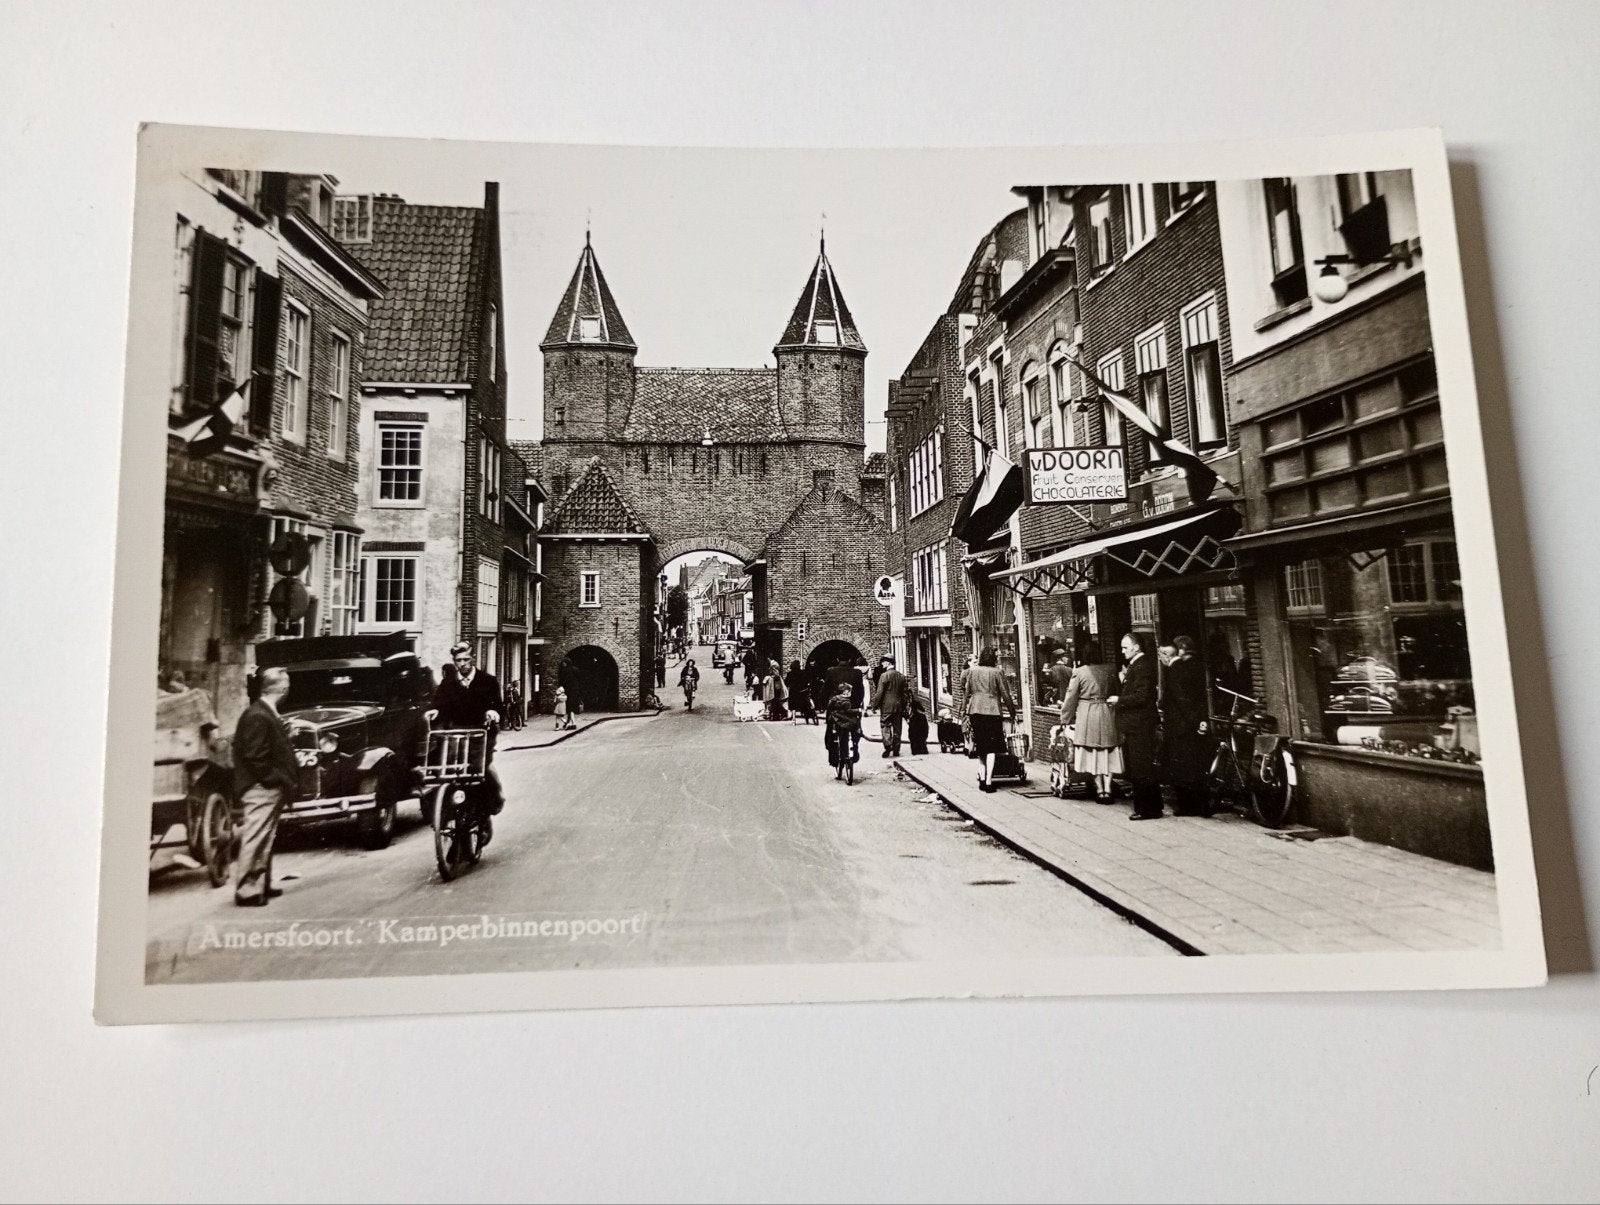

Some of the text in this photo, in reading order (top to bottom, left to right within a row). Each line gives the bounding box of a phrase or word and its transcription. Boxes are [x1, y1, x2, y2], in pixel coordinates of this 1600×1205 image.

[1033, 472, 1123, 485] Fruit Conserven
[1033, 485, 1124, 500] CHOCOLATERIE
[200, 913, 642, 949] Amersfoort. Kamperbinnenpoort
